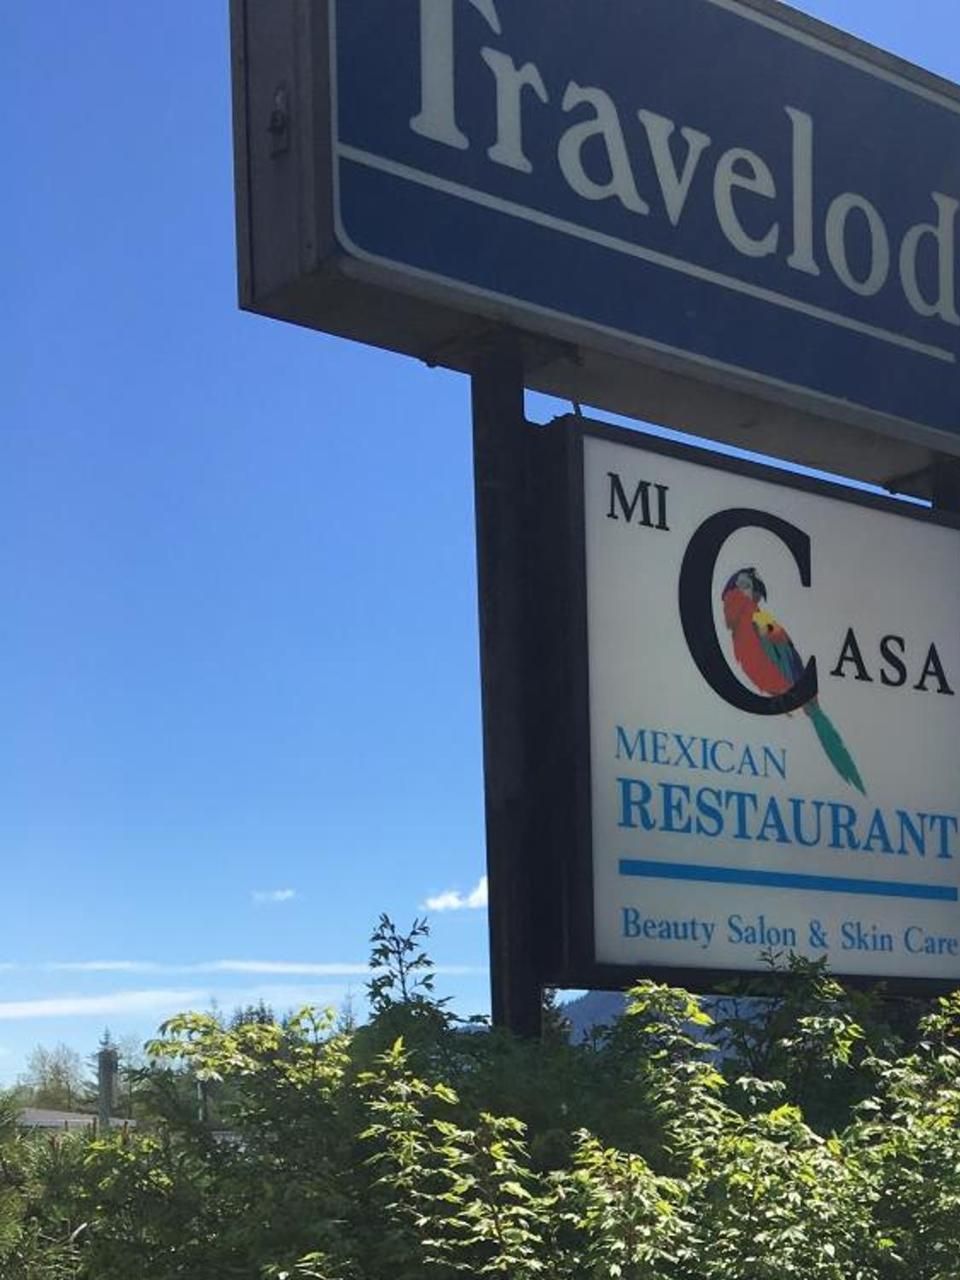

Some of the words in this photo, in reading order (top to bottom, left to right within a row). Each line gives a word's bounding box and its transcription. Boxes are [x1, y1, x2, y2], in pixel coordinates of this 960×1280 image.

[606, 472, 671, 531] MI
[615, 726, 787, 779] MEXICAN
[616, 779, 958, 859] RESTAURANT
[622, 907, 715, 948] Beauty
[727, 915, 797, 948] Salon
[809, 920, 828, 949] &
[841, 923, 893, 953] Skin
[904, 926, 959, 956] Care
